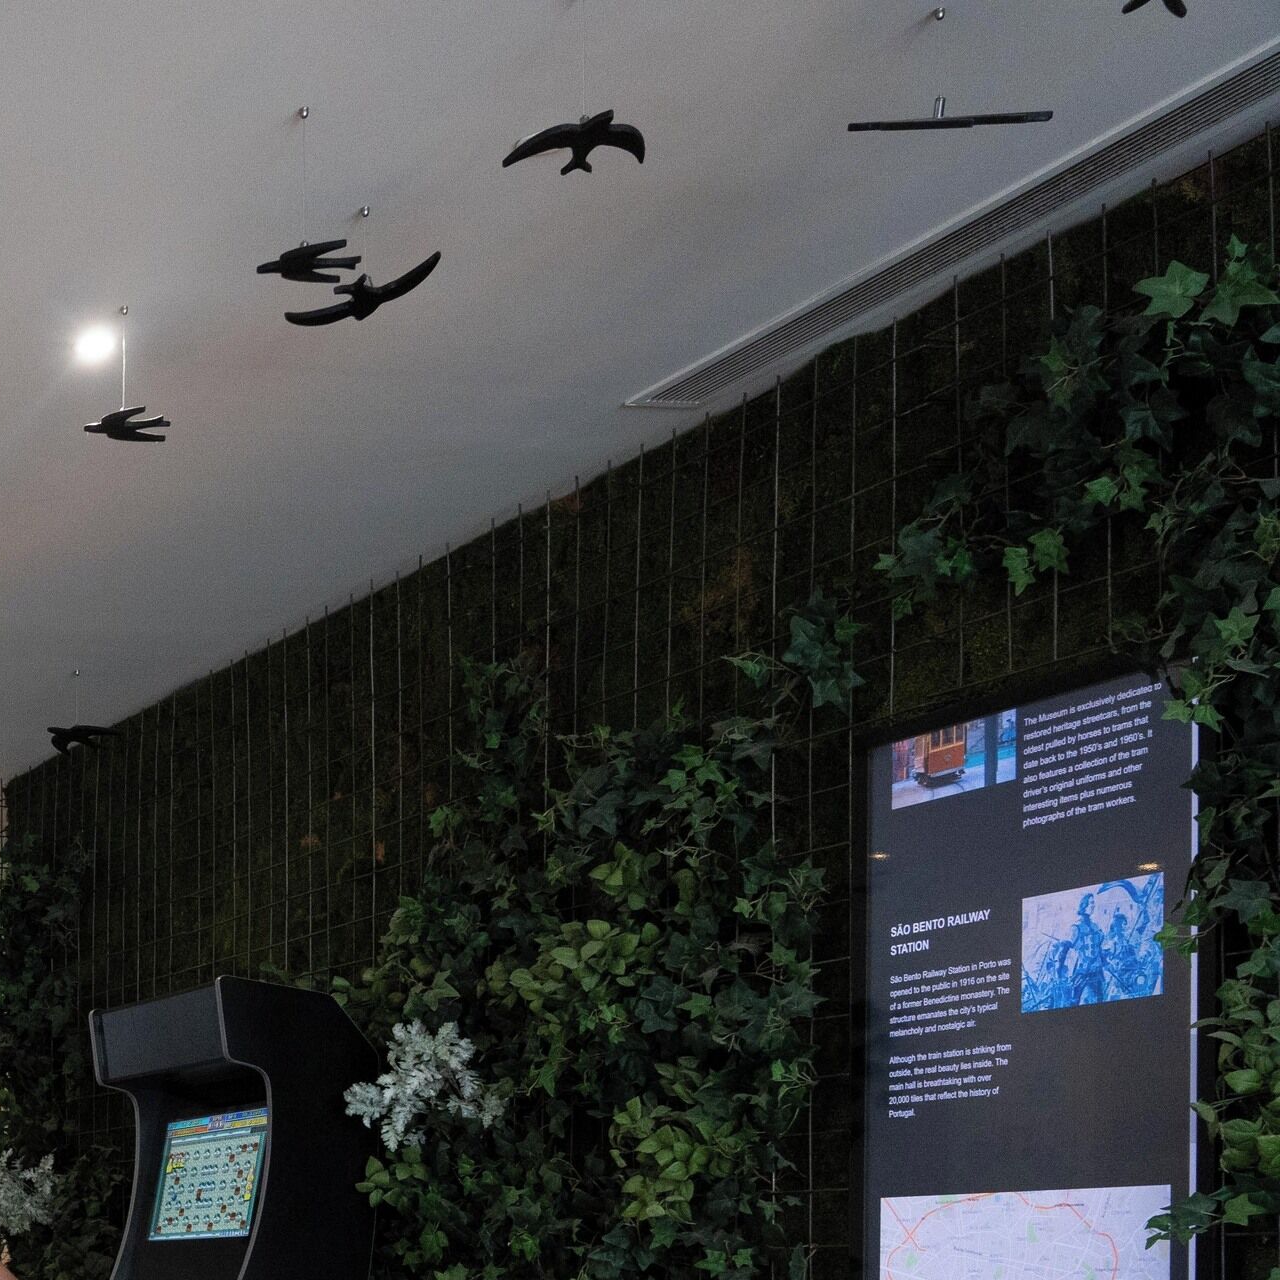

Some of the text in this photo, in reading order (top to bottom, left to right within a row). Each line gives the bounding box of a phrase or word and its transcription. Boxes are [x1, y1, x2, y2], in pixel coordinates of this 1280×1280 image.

[1024, 683, 1162, 727] The Museum is exclusively dedicated to
[1024, 700, 1152, 741] restored heritage streetcars, from the
[1024, 715, 1149, 755] oldest pulled by horses to trams that
[1023, 729, 1153, 769] date back to the 1950's and 1960's. It
[1023, 775, 1038, 784] also
[1039, 767, 1067, 780] features
[1074, 757, 1108, 771] collection
[1109, 752, 1117, 763] of
[1118, 751, 1130, 760] the
[1131, 746, 1149, 757] tram
[1023, 763, 1143, 799] driver's original uniforms and other
[1023, 780, 1133, 813] interesting items plus numerous
[1023, 795, 1137, 829] photographs of the tram workers.
[890, 909, 991, 938] SÃO BENTO RAILWAY
[890, 939, 930, 956] STATION
[890, 958, 1012, 984] São Bento Railway Station in Porto was
[890, 971, 1010, 999] opened to the public in 1916 on the site
[890, 1002, 896, 1011] of
[902, 1000, 923, 1009] former
[923, 994, 960, 1006] Benedictine
[960, 989, 996, 1001] monastery.
[996, 986, 1010, 995] The
[890, 1001, 999, 1025] structure emanates the city's typical
[889, 1018, 977, 1038] melancholy and nostalgic air.
[889, 1043, 1012, 1065] Although the train station is striking from
[889, 1057, 1009, 1078] outside, the real beauty lies inside. The
[888, 1085, 1000, 1106] 20,000 tiles that reflect the history of
[889, 1074, 992, 1091] main hall is breathtaking with over
[888, 1107, 916, 1119] Portugal.
